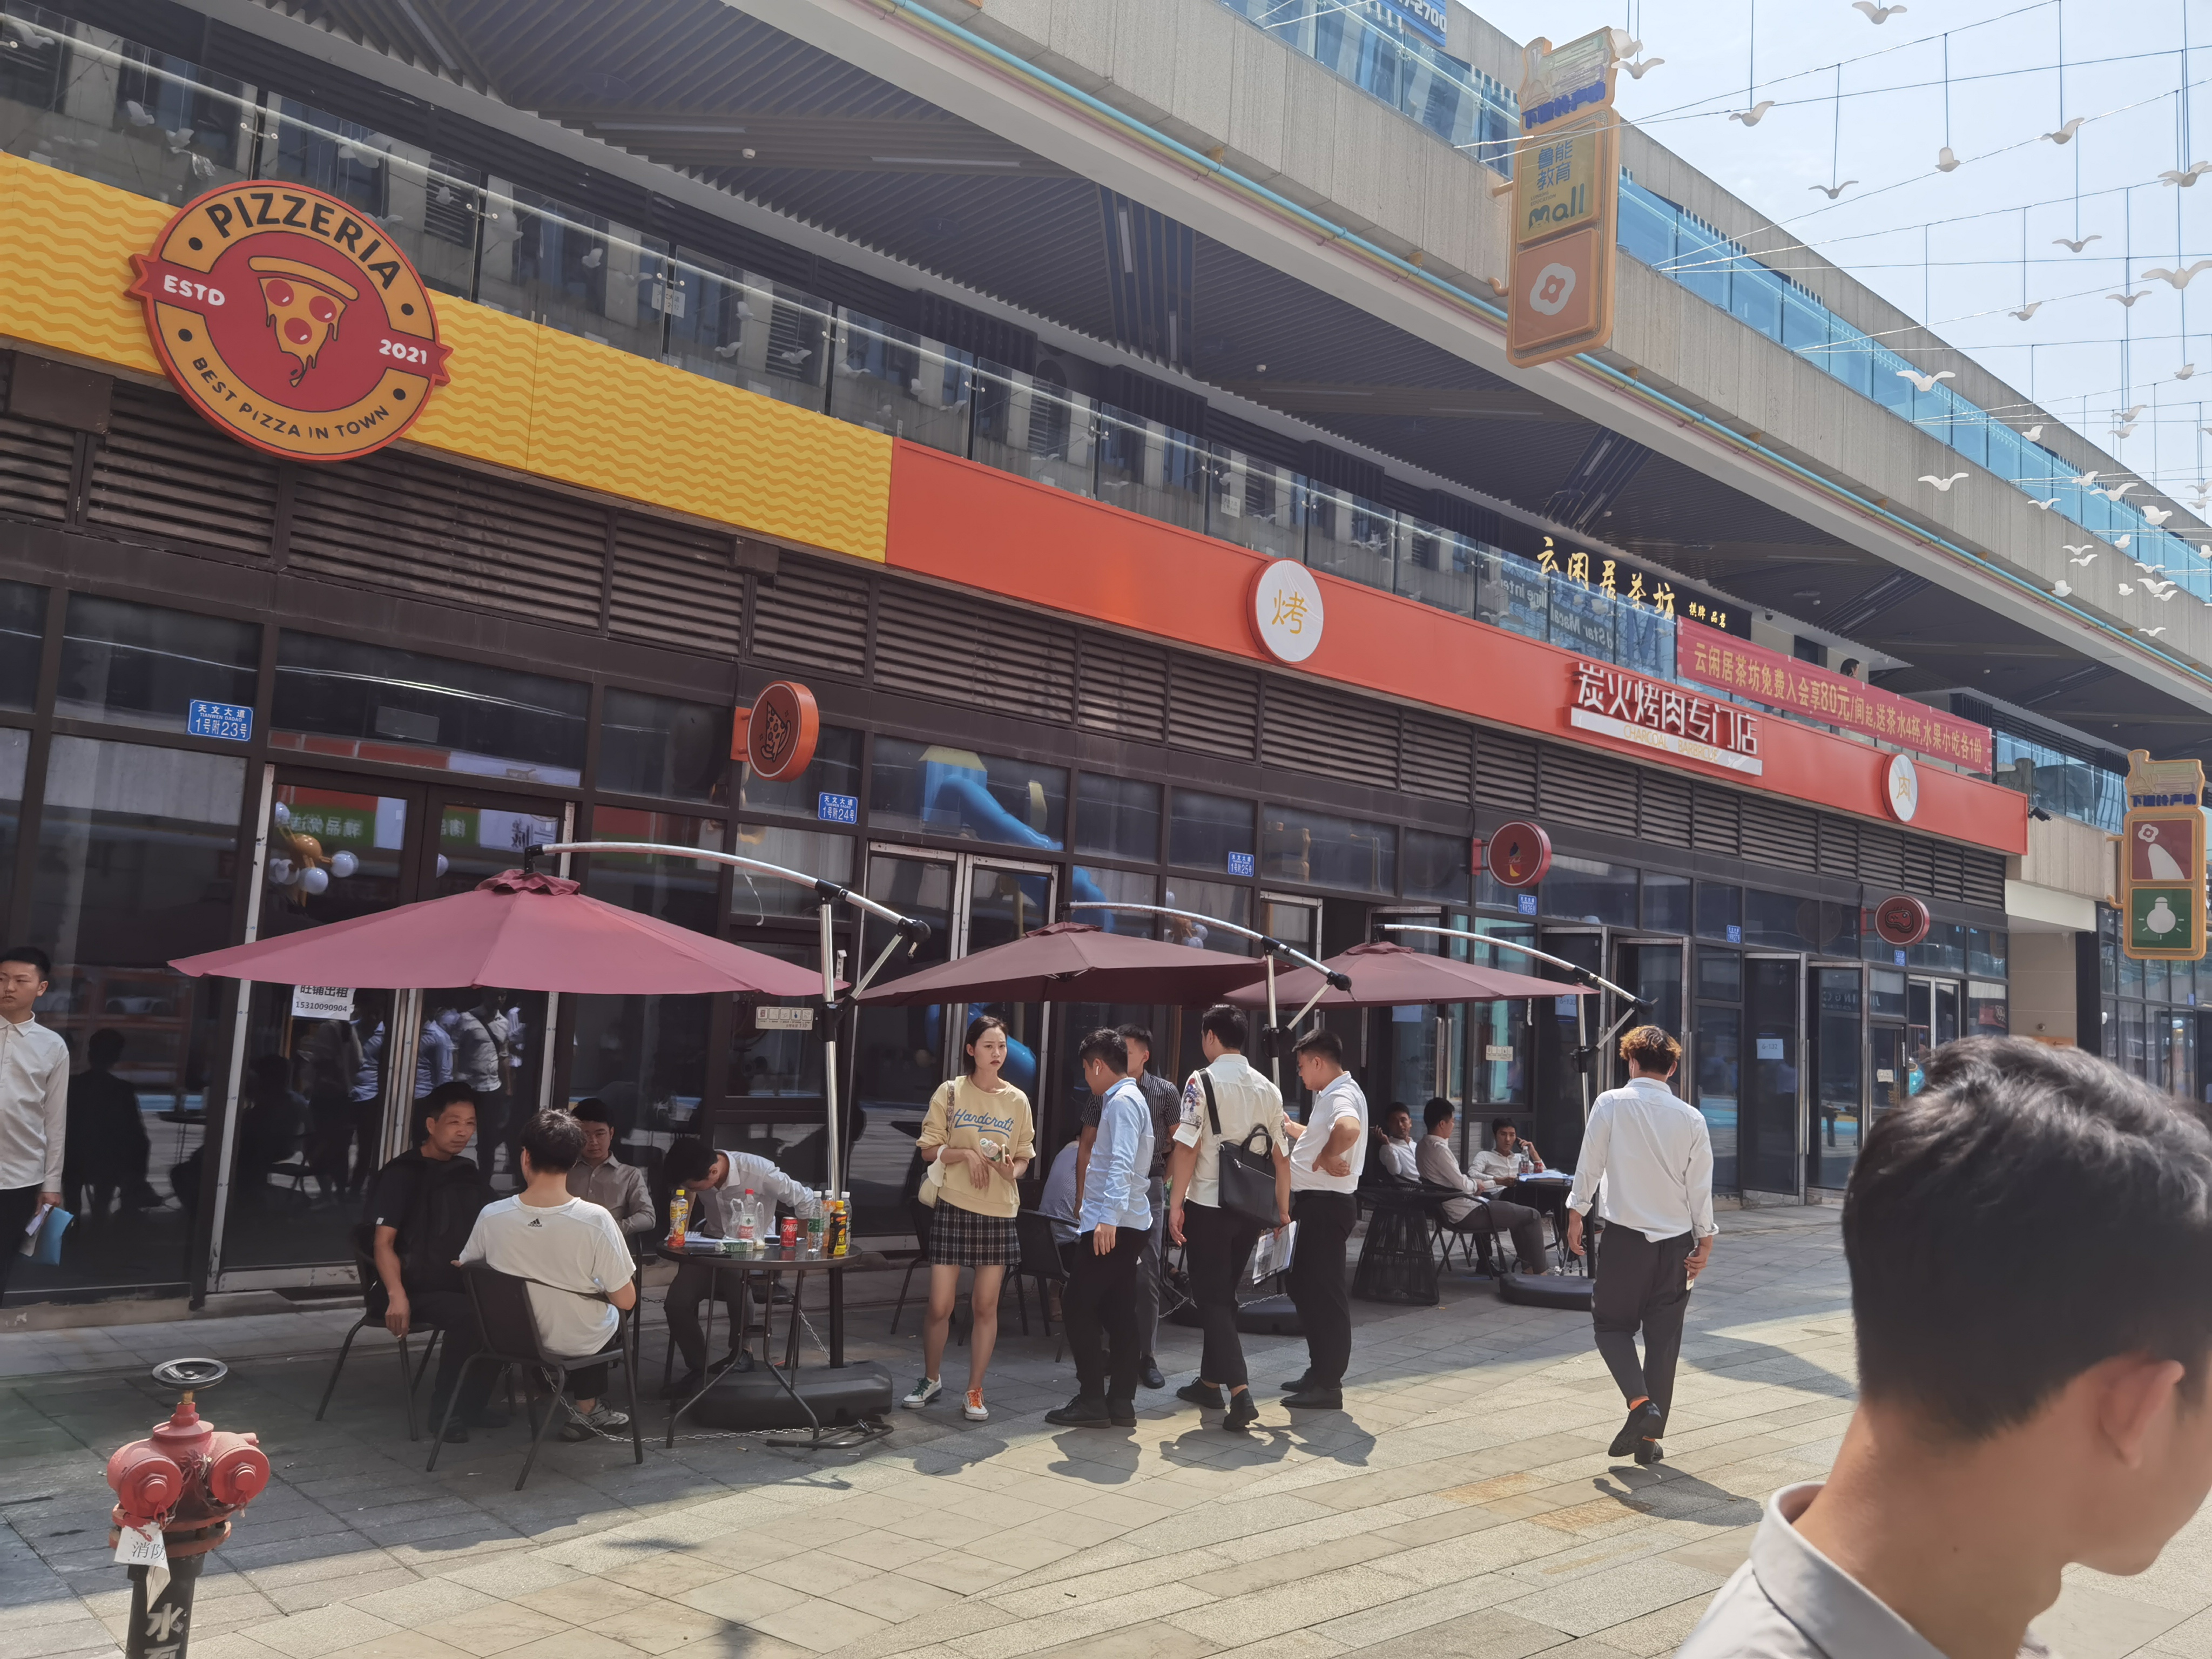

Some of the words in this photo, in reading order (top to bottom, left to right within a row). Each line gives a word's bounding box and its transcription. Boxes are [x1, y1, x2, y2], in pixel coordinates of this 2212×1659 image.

[1538, 139, 1574, 170] 鲁能
[1537, 161, 1571, 191] 教育
[1530, 194, 1556, 206] EDUCATION
[205, 193, 400, 289] PIZZERIA
[164, 274, 225, 306] ESTD
[379, 339, 427, 365] 2021
[193, 357, 237, 401] BEST
[239, 402, 300, 437] PIZZA
[309, 427, 329, 439] IN
[335, 405, 389, 436] TOWN
[1537, 537, 1675, 619] 云闲居茶坊
[1272, 589, 1308, 634] 烤
[1689, 602, 1706, 620] 棋牌
[198, 704, 246, 718] 天文大道
[1577, 663, 1758, 756] 炭火烤肉专门店
[195, 718, 247, 738] 1号附23号
[1623, 725, 1668, 750] CHARCOAL
[824, 795, 853, 806] 天文大道
[1896, 774, 1911, 802] 肉
[822, 806, 854, 821] 1号附24号
[300, 985, 349, 997] 旺铺出租
[296, 1001, 347, 1012] 15310090904
[132, 1542, 166, 1561] 消防
